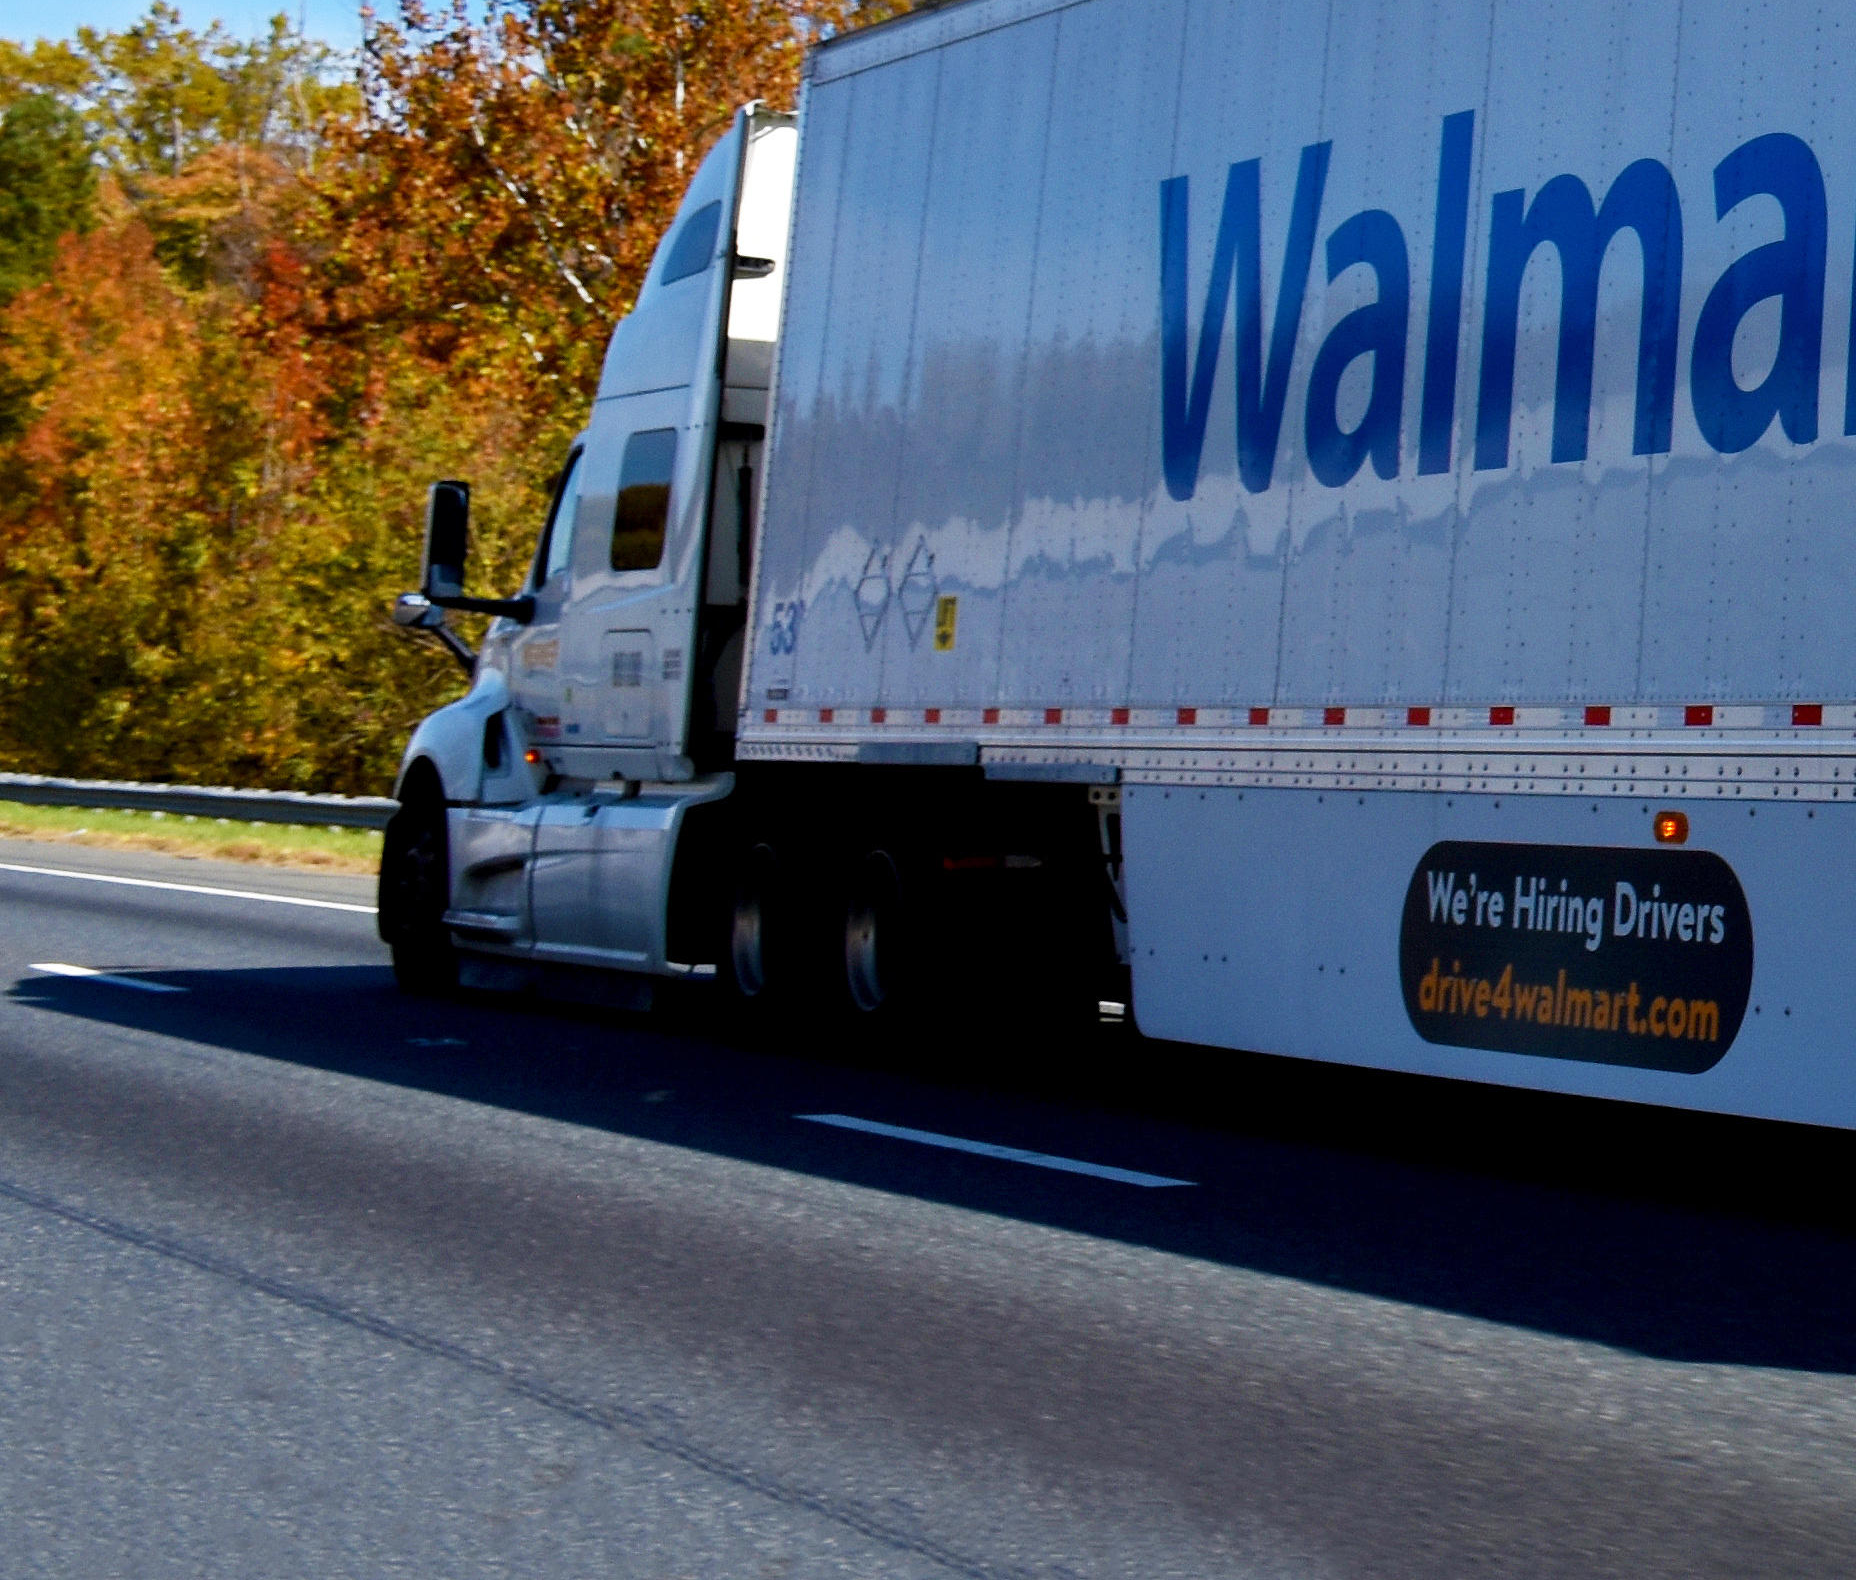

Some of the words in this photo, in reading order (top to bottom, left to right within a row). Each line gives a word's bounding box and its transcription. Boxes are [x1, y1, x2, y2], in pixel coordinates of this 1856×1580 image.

[1426, 870, 1505, 928] We're
[1512, 875, 1605, 952] Hiring
[1613, 880, 1726, 945] Drivers
[1418, 957, 1720, 1042] drive4walmart.com
